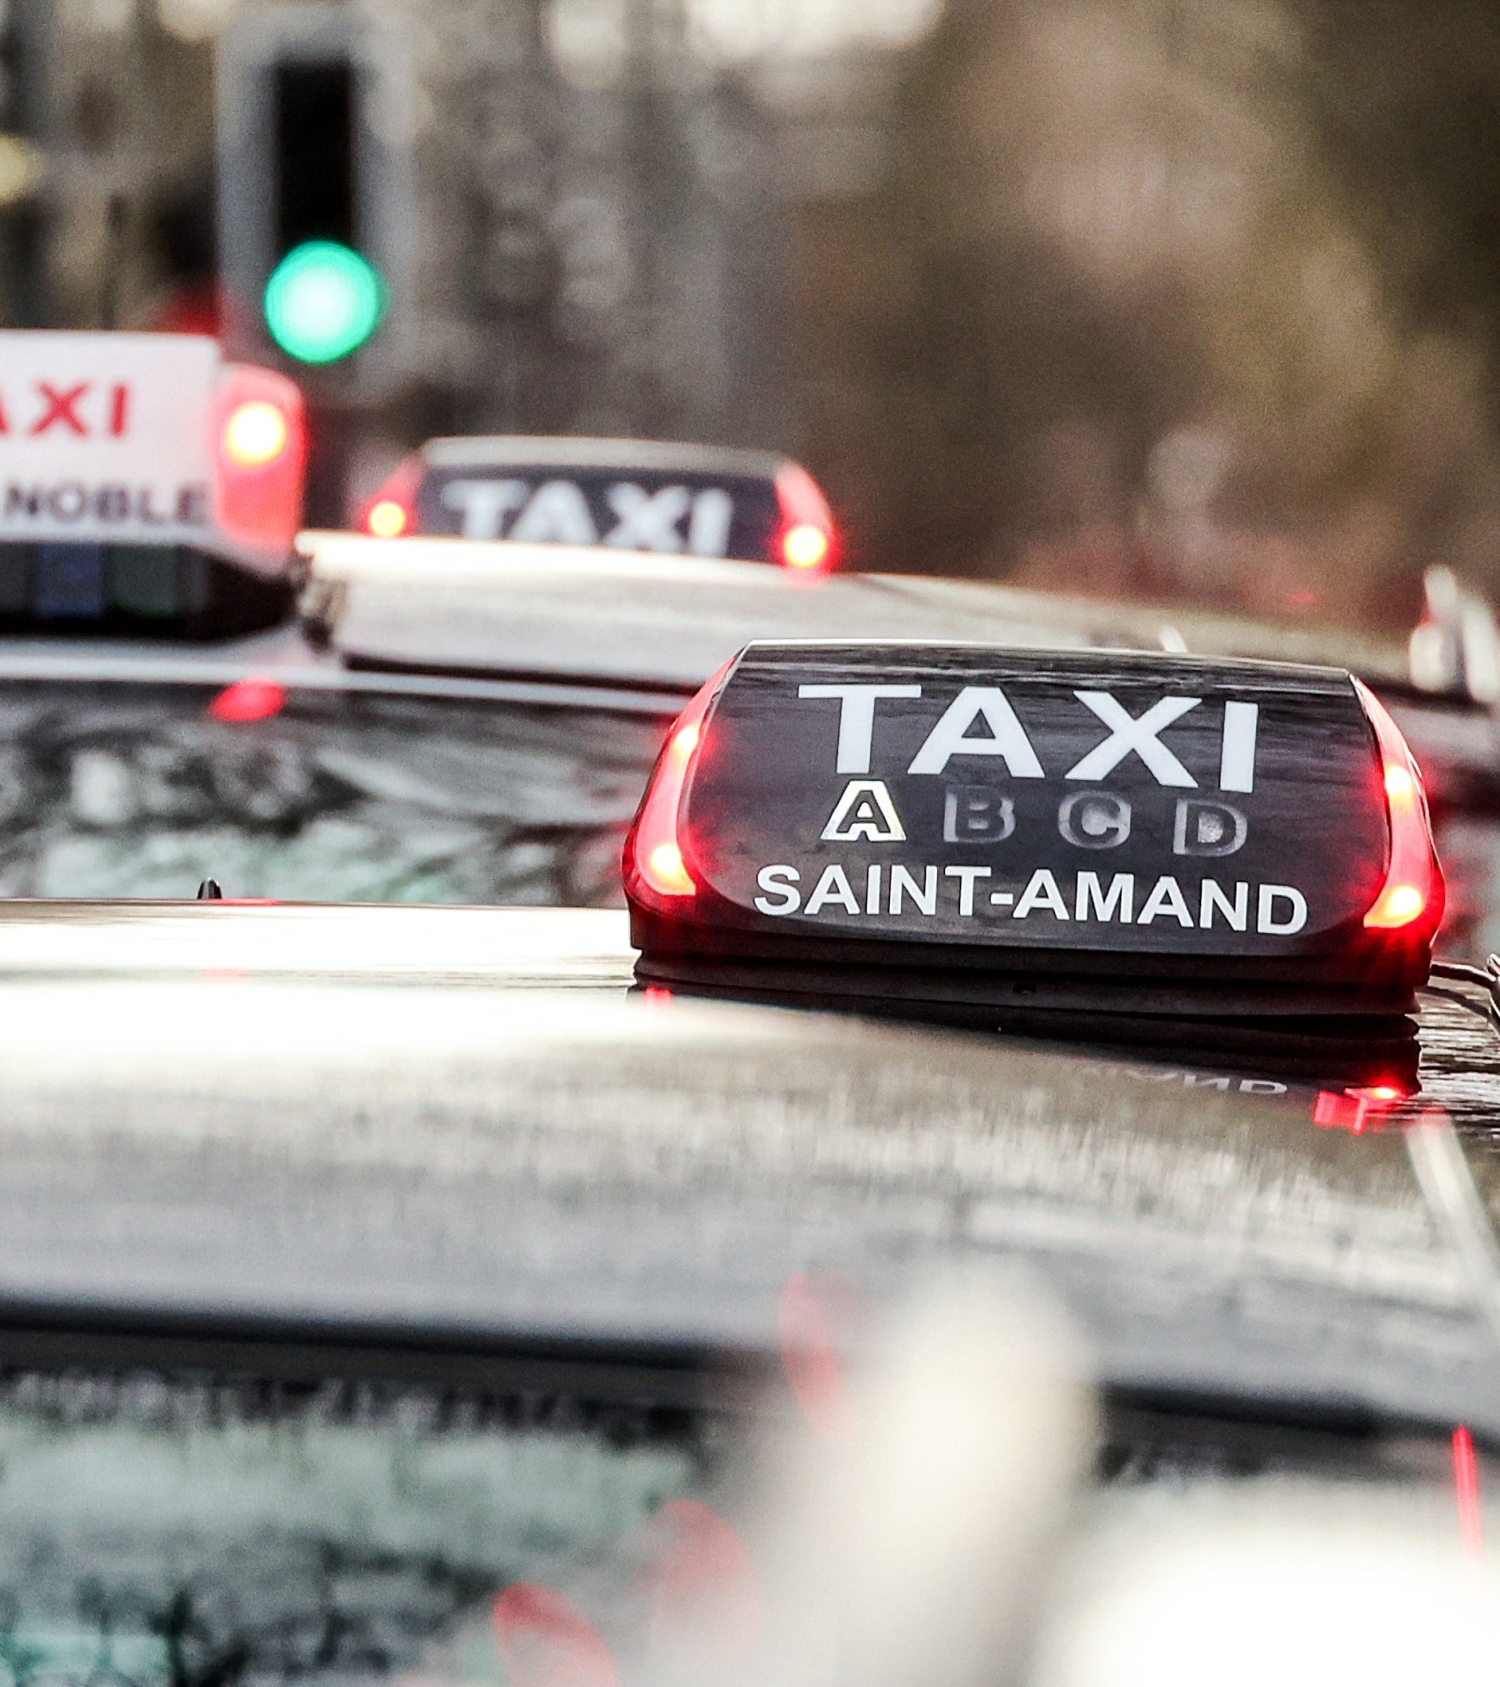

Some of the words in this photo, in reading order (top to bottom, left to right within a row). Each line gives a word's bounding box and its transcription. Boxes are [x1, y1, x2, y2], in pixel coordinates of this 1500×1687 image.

[6, 481, 208, 524] NOBLE
[443, 480, 730, 557] TAXI
[799, 686, 1258, 793] TAXI
[821, 780, 906, 841] A
[943, 786, 1016, 843] B
[1057, 792, 1131, 849] C
[1173, 800, 1248, 856] D
[755, 864, 1308, 935] SAINT-AMAND
